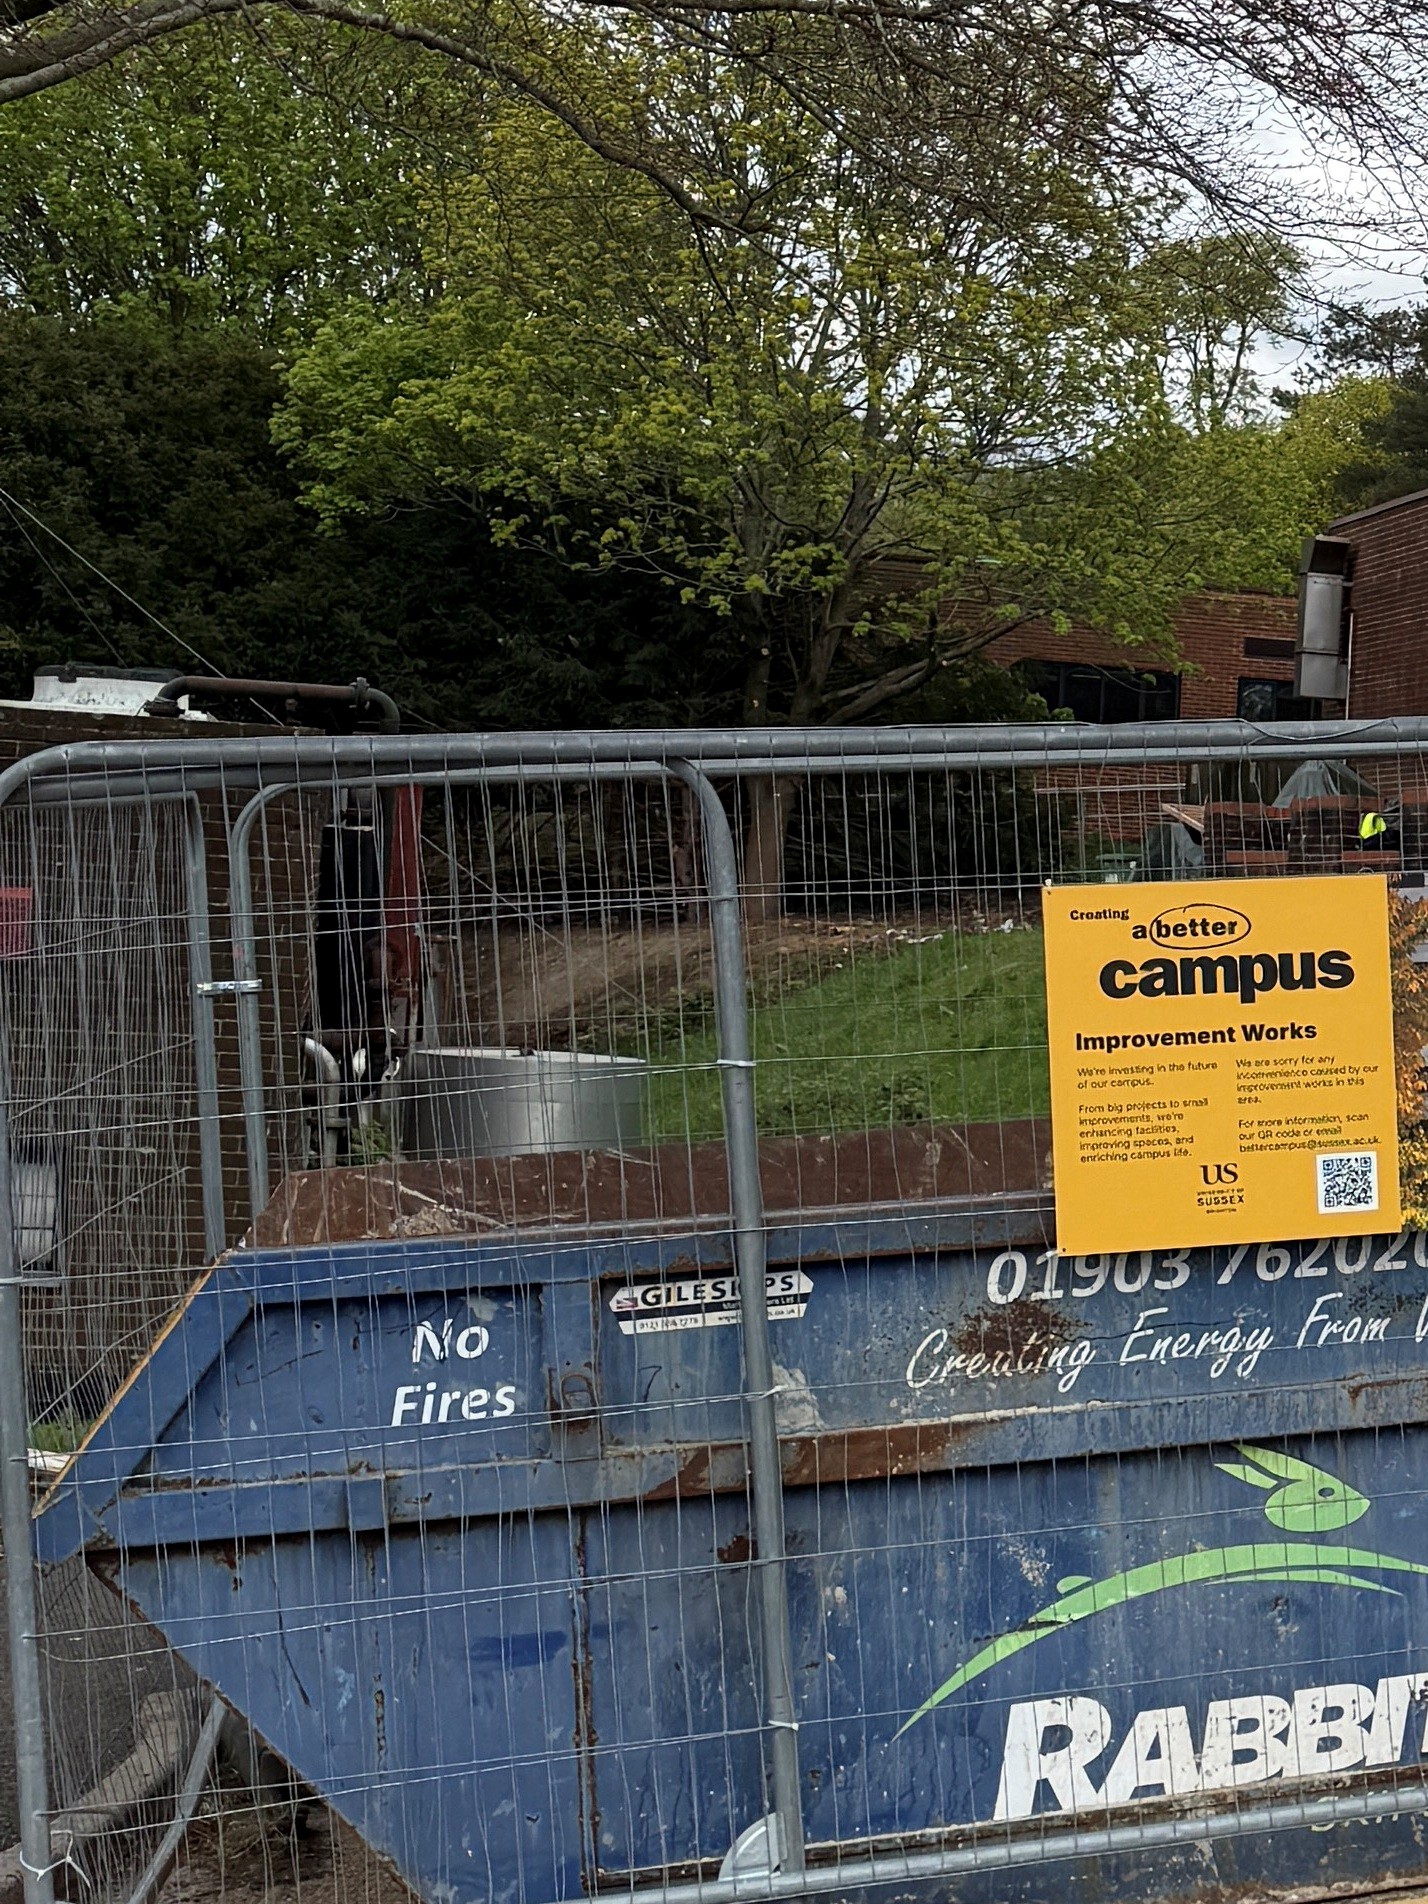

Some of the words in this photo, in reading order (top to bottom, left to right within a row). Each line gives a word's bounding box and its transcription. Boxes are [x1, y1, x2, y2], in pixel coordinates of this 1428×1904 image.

[1070, 908, 1130, 921] Creating
[1132, 924, 1147, 939] a
[1155, 918, 1238, 939] better
[1100, 950, 1355, 1004] campus
[1075, 1025, 1236, 1053] Improvement
[1241, 1022, 1317, 1042] Works
[1077, 1067, 1106, 1077] We're
[1109, 1065, 1154, 1075] investing
[1157, 1064, 1166, 1072] in
[1169, 1063, 1185, 1071] the
[1188, 1061, 1218, 1071] future
[1236, 1059, 1251, 1068] We
[1273, 1056, 1298, 1066] sorry
[1301, 1055, 1314, 1064] for
[1317, 1055, 1335, 1065] any
[1236, 1069, 1307, 1080] inconvenience
[1310, 1065, 1346, 1076] caused
[1349, 1065, 1360, 1075] by
[1362, 1064, 1379, 1073] our
[1077, 1080, 1088, 1090] of
[1091, 1080, 1107, 1089] our
[1110, 1077, 1155, 1089] campus.
[1236, 1081, 1301, 1092] improvement
[1303, 1079, 1333, 1089] works
[1335, 1078, 1345, 1086] in
[1347, 1077, 1365, 1086] this
[1079, 1104, 1104, 1114] From
[1107, 1103, 1123, 1114] big
[1126, 1100, 1167, 1112] projects
[1170, 1100, 1179, 1108] to
[1183, 1098, 1208, 1107] small
[1157, 1112, 1184, 1121] we're
[1238, 1119, 1254, 1128] For
[1257, 1118, 1282, 1127] more
[1285, 1114, 1342, 1126] information,
[1346, 1113, 1369, 1121] scan
[1079, 1127, 1132, 1138] enhancing
[1238, 1132, 1254, 1141] our
[1258, 1130, 1273, 1139] QR
[1275, 1128, 1301, 1138] code
[1303, 1128, 1313, 1136] or
[1316, 1125, 1342, 1136] email
[1080, 1139, 1130, 1151] improving
[1133, 1137, 1172, 1148] spaces,
[1175, 1136, 1194, 1144] and
[1080, 1151, 1128, 1163] enriching
[1130, 1149, 1171, 1160] campus
[1174, 1148, 1192, 1157] life.
[1197, 1195, 1244, 1206] SUSSEX
[987, 1247, 1190, 1305] 01903
[412, 1319, 490, 1364] No
[906, 1327, 1096, 1394] Creating
[1119, 1307, 1275, 1379] Energy
[1294, 1292, 1390, 1347] From
[390, 1382, 517, 1428] Fires
